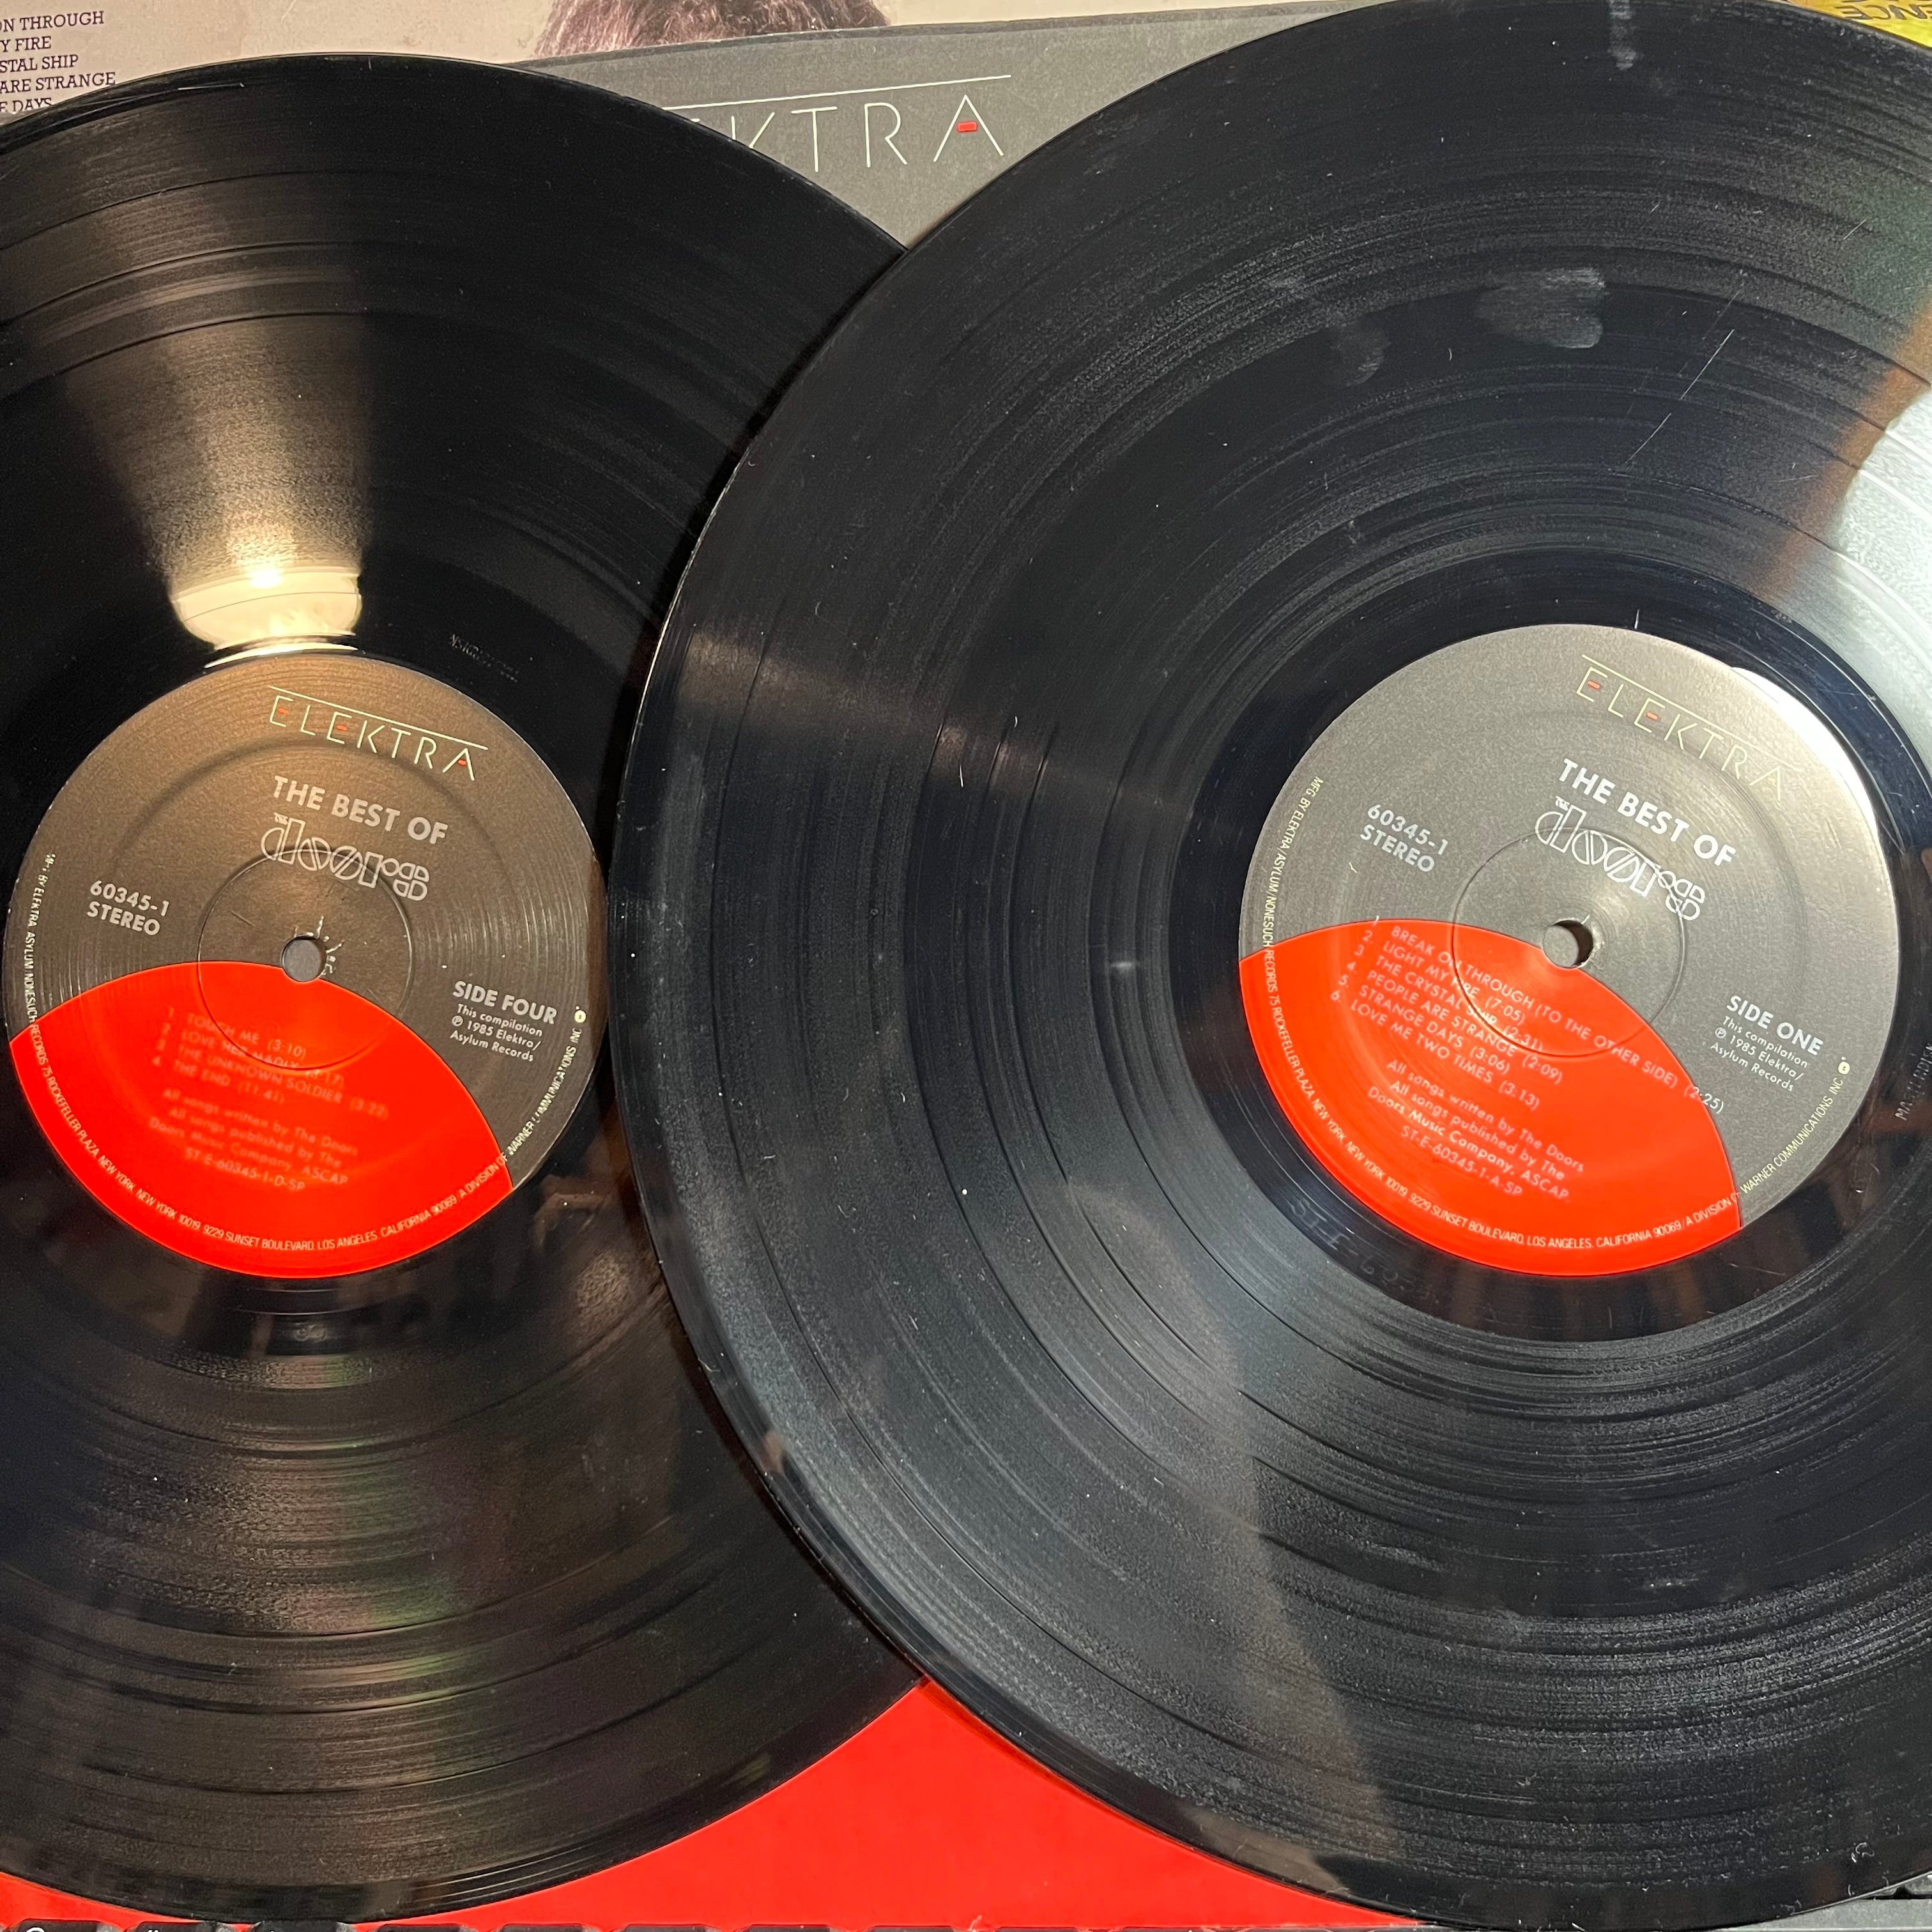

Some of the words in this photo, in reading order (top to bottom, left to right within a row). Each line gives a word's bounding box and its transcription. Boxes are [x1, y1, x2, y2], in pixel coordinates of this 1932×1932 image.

[20, 11, 104, 31] THROUGH
[15, 36, 52, 51] FIRE
[42, 54, 79, 70] SHIP
[35, 72, 116, 91] STRANGE
[269, 695, 475, 781] ELEKTRA
[1576, 666, 1782, 801] ELEKTRA
[274, 776, 325, 810] THE
[332, 793, 400, 831] BEST
[408, 816, 448, 844] OF
[1298, 797, 1311, 812] BY
[1558, 758, 1616, 804] THE
[1617, 792, 1689, 843] BEST
[1693, 835, 1736, 866] OF
[1367, 804, 1448, 855] 60345-1
[1360, 824, 1434, 872] STEREO
[90, 880, 169, 916] 60345-1
[87, 901, 160, 935] STEREO
[1264, 949, 1278, 993] RECORDS
[1376, 955, 1402, 976] THE
[1406, 971, 1462, 1009] CRYSTAL
[1383, 940, 1425, 968] LIGHT
[1425, 964, 1450, 981] MY
[1485, 996, 1525, 1025] (7:05)
[452, 981, 498, 1007] SIDE
[502, 995, 557, 1024] FOUR
[1268, 995, 1280, 1006] 75
[457, 1004, 477, 1018] This
[480, 1013, 542, 1037] compilation
[468, 1020, 493, 1036] 1985
[496, 1029, 541, 1051] Elektra/
[1359, 985, 1424, 1026] STRANGE
[1426, 1020, 1464, 1048] DAYS
[1470, 1046, 1510, 1074] (3:06)
[1367, 970, 1419, 1004] PEOPLE
[1420, 1000, 1450, 1020] ARE
[1452, 1015, 1517, 1057] STRANGE
[1522, 1053, 1563, 1085] (2:09)
[1392, 926, 1436, 956] BREAK
[1465, 963, 1535, 1009] THROUGH
[1535, 1004, 1561, 1023] (TO
[1565, 1018, 1591, 1039] THE
[1594, 1035, 1639, 1066] OTHER
[1642, 1061, 1678, 1089] SIDE)
[1684, 1085, 1724, 1114] (2:25)
[1726, 995, 1774, 1029] SIDE
[1776, 1022, 1823, 1055] ONE
[31, 1023, 49, 1066] RECORDS
[240, 1031, 259, 1044] ME
[450, 1030, 488, 1048] Asylum
[491, 1041, 534, 1062] Records
[1272, 1006, 1300, 1069] ROCKEFELLER
[1723, 1016, 1742, 1033] This
[1745, 1031, 1807, 1068] compilation
[1351, 999, 1388, 1025] LOVE
[1390, 1022, 1413, 1039] ME
[1416, 1032, 1450, 1059] TWO
[1453, 1054, 1493, 1083] TIMES
[1498, 1080, 1540, 1111] (3:13)
[1710, 1042, 1749, 1068] Asylum
[1751, 1063, 1794, 1092] Records
[1730, 1035, 1756, 1055] 1985
[1758, 1052, 1804, 1081] Elektra/
[42, 1065, 53, 1078] 75
[207, 1055, 283, 1084] UNKNOWN
[287, 1077, 342, 1104] SOLDIER
[1828, 1077, 1843, 1094] INC
[47, 1076, 82, 1131] ROCKEFELLER
[1312, 1099, 1330, 1119] NEW
[1386, 1059, 1407, 1075] All
[1407, 1073, 1445, 1098] songs
[1450, 1094, 1494, 1123] written
[1498, 1117, 1515, 1135] by
[1519, 1128, 1542, 1149] The
[1546, 1144, 1584, 1172] Doors
[1368, 1085, 1405, 1114] Doors
[1409, 1109, 1446, 1136] Music
[1521, 1170, 1569, 1199] ASCAP
[1390, 1080, 1410, 1096] All
[1411, 1093, 1448, 1117] songs
[1519, 1148, 1537, 1167] by
[1541, 1159, 1565, 1180] The
[98, 1154, 116, 1175] NEW
[1345, 1141, 1365, 1162] NEW
[464, 1163, 500, 1194] DIVISION
[1363, 1158, 1386, 1181] YORK
[1740, 1163, 1776, 1193] WARNER
[136, 1188, 155, 1207] NEW
[1385, 1176, 1408, 1197] 10019
[1409, 1192, 1431, 1211] 9229
[156, 1200, 178, 1220] YORK
[178, 1214, 201, 1231] 10019
[380, 1209, 432, 1238] CALIFORNIA
[1430, 1204, 1469, 1229] SUNSET
[1692, 1197, 1732, 1223] DIVISION
[203, 1224, 224, 1239] 9229
[224, 1231, 261, 1248] SUNSET
[317, 1239, 335, 1250] LOS
[1526, 1235, 1546, 1246] LOS
[1596, 1229, 1652, 1248] CALIFORNIA
